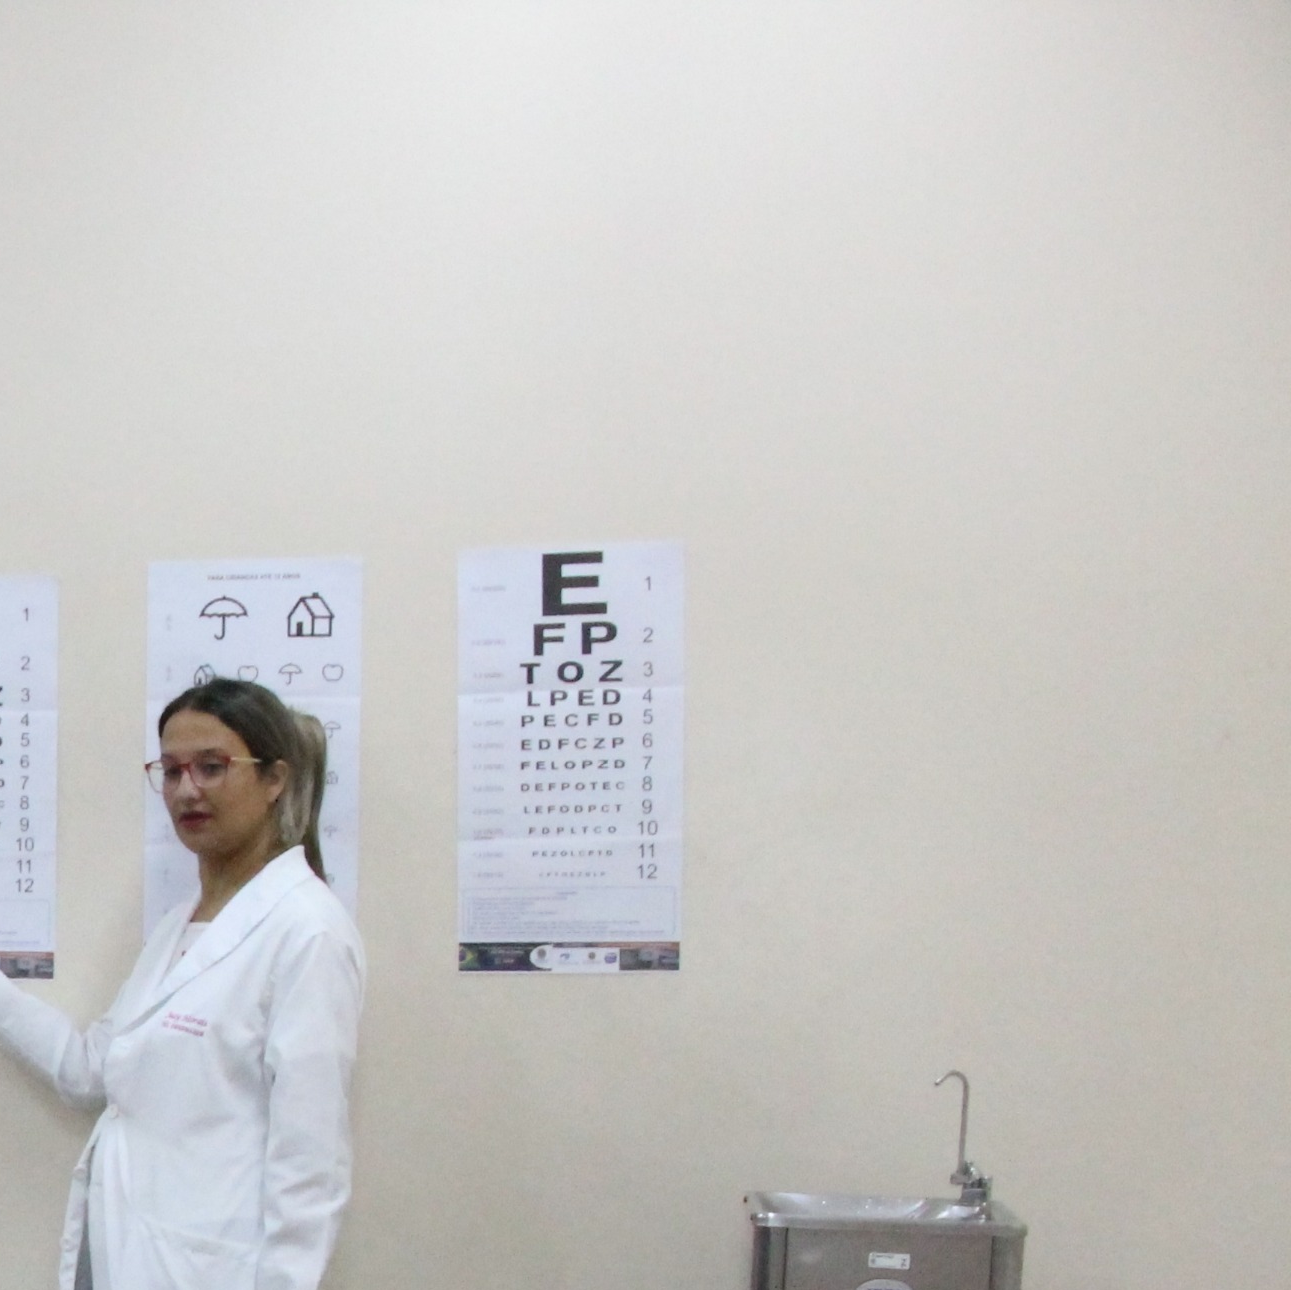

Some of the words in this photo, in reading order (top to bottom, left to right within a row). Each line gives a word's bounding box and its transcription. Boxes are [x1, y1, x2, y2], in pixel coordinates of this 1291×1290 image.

[542, 551, 607, 616] E
[645, 575, 652, 590] 1
[23, 607, 29, 621] 1
[642, 627, 653, 643] 2
[20, 656, 30, 671] 2
[643, 661, 653, 677] 3
[20, 688, 30, 702] 3
[643, 688, 652, 703] 4
[20, 713, 29, 726] 4
[643, 709, 653, 724] 5
[20, 733, 30, 747] 5
[642, 733, 653, 748] 6
[20, 755, 29, 769] 6
[642, 755, 652, 770] 7
[20, 776, 29, 790] 7
[642, 776, 652, 791] 8
[20, 796, 29, 810] 8
[641, 799, 653, 814] 9
[20, 817, 29, 832] 9
[638, 820, 658, 835] 10
[15, 837, 34, 851] 10
[638, 843, 655, 858] 11
[16, 859, 32, 873] 11
[638, 864, 658, 879] 12
[15, 879, 34, 893] 12
